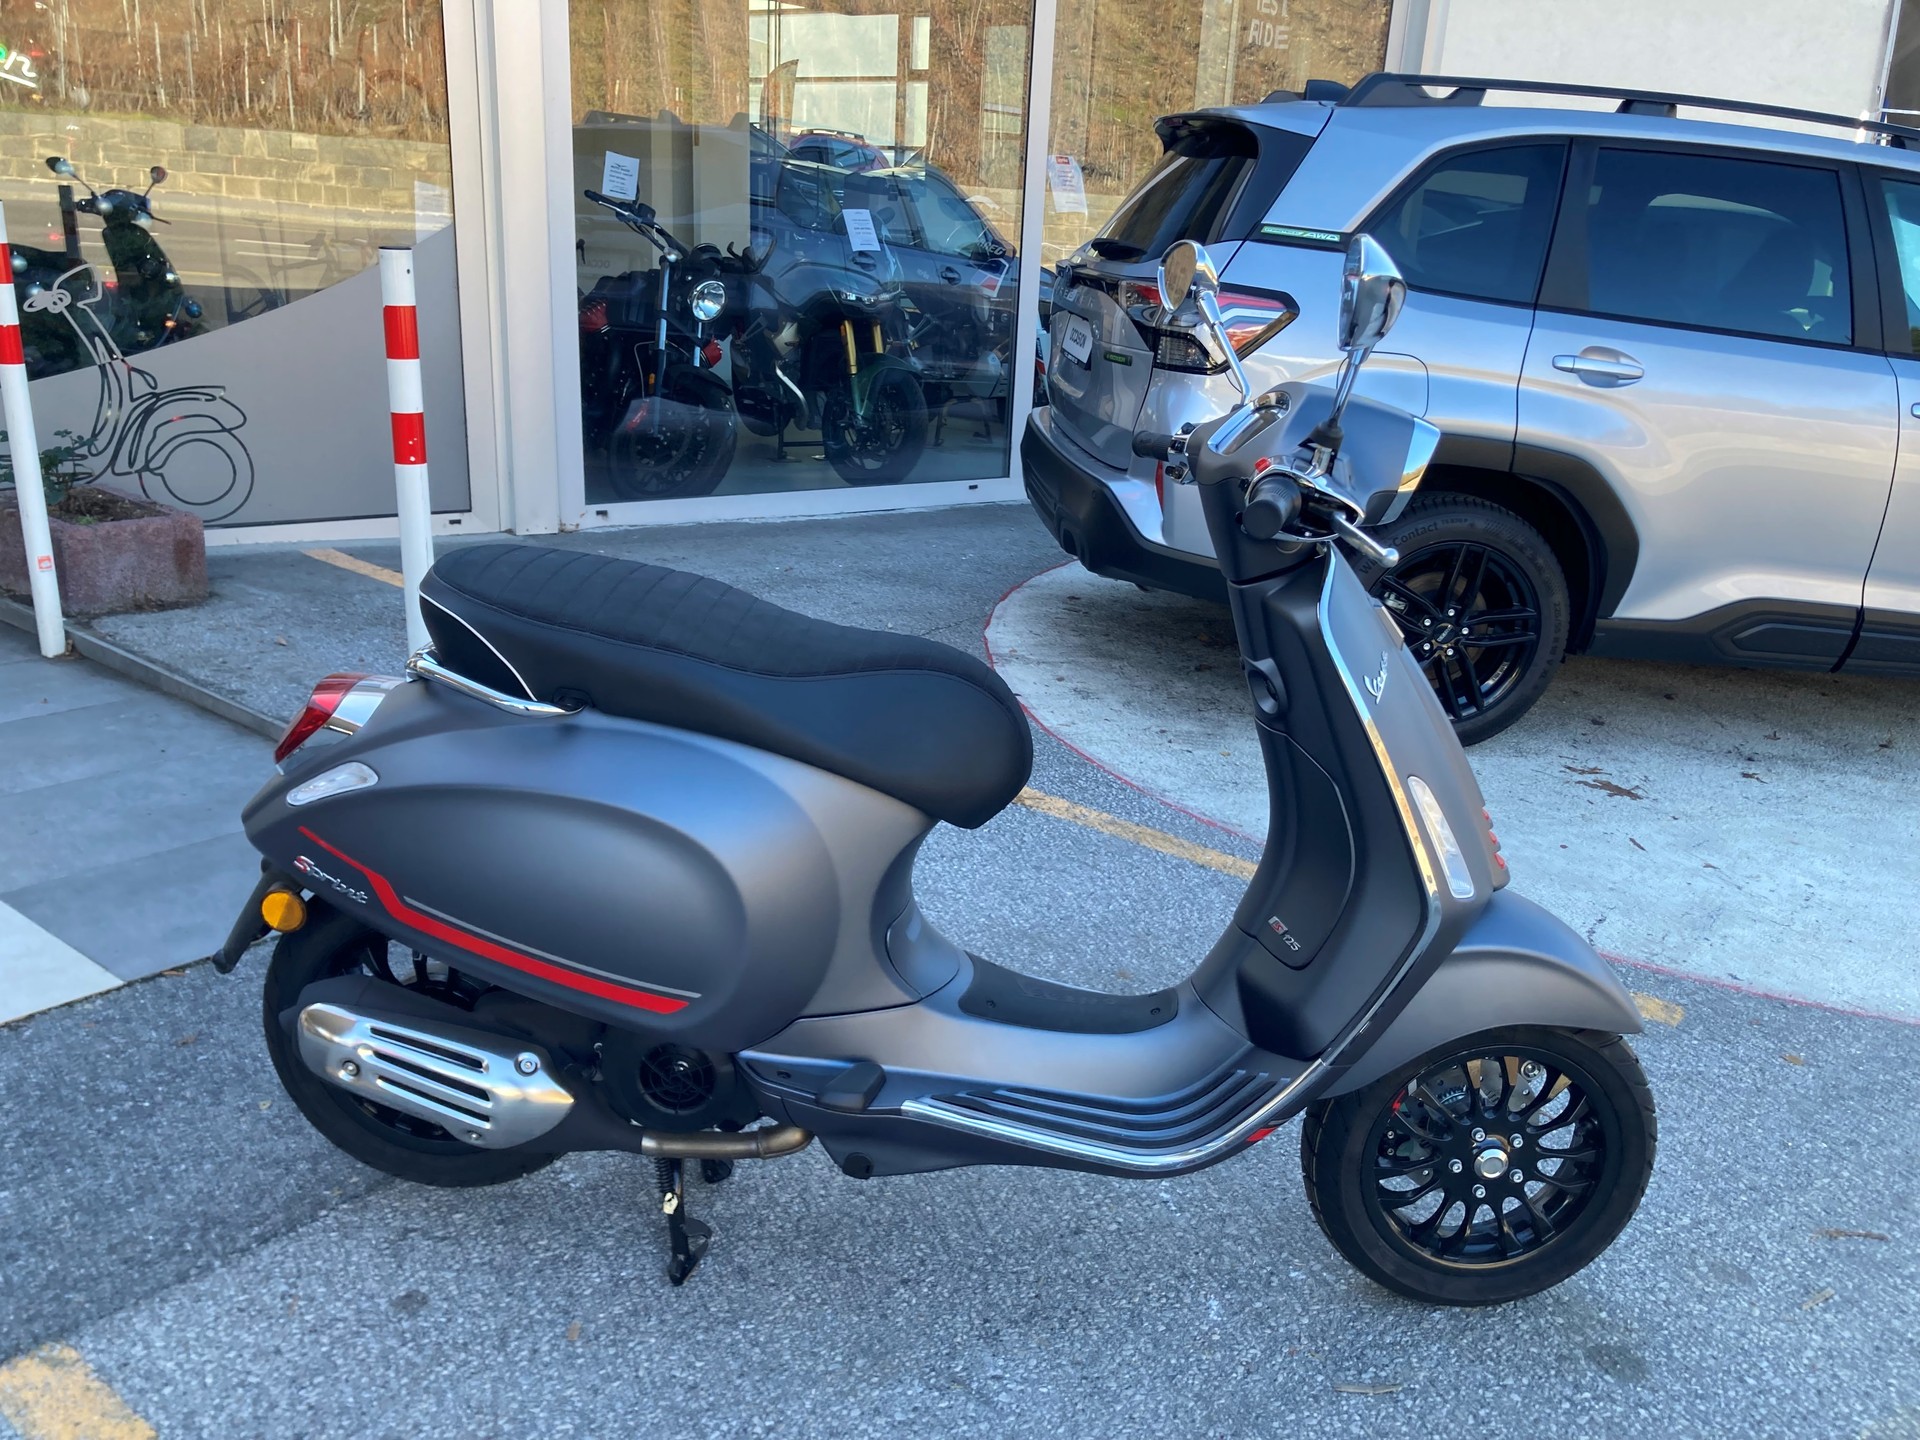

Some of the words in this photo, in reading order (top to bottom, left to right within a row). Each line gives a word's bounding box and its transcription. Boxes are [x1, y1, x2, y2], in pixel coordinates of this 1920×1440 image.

[1249, 18, 1290, 49] RIDE
[1303, 231, 1339, 241] AWD
[1363, 650, 1388, 704] Vespa
[294, 855, 369, 904] Sprint
[1283, 935, 1302, 951] 125
